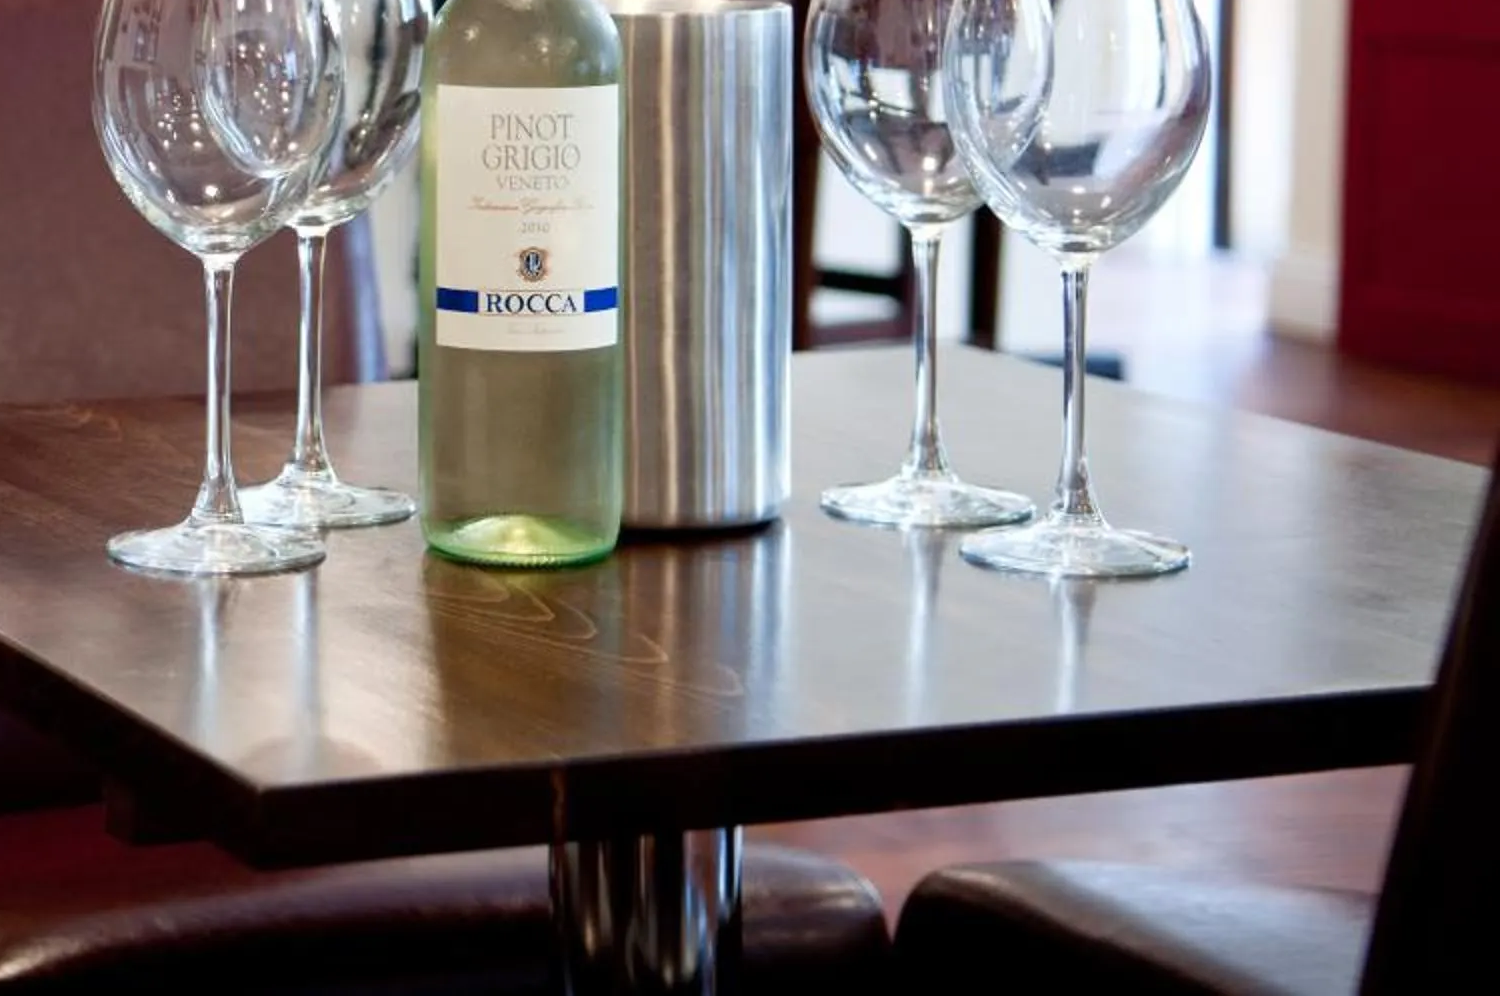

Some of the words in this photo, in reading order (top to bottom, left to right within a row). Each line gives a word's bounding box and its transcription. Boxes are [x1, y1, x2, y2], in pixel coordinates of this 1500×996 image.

[491, 113, 574, 141] PINOT
[482, 144, 581, 171] GRIGIO
[496, 175, 570, 191] VENETO
[486, 293, 577, 313] ROCCA
